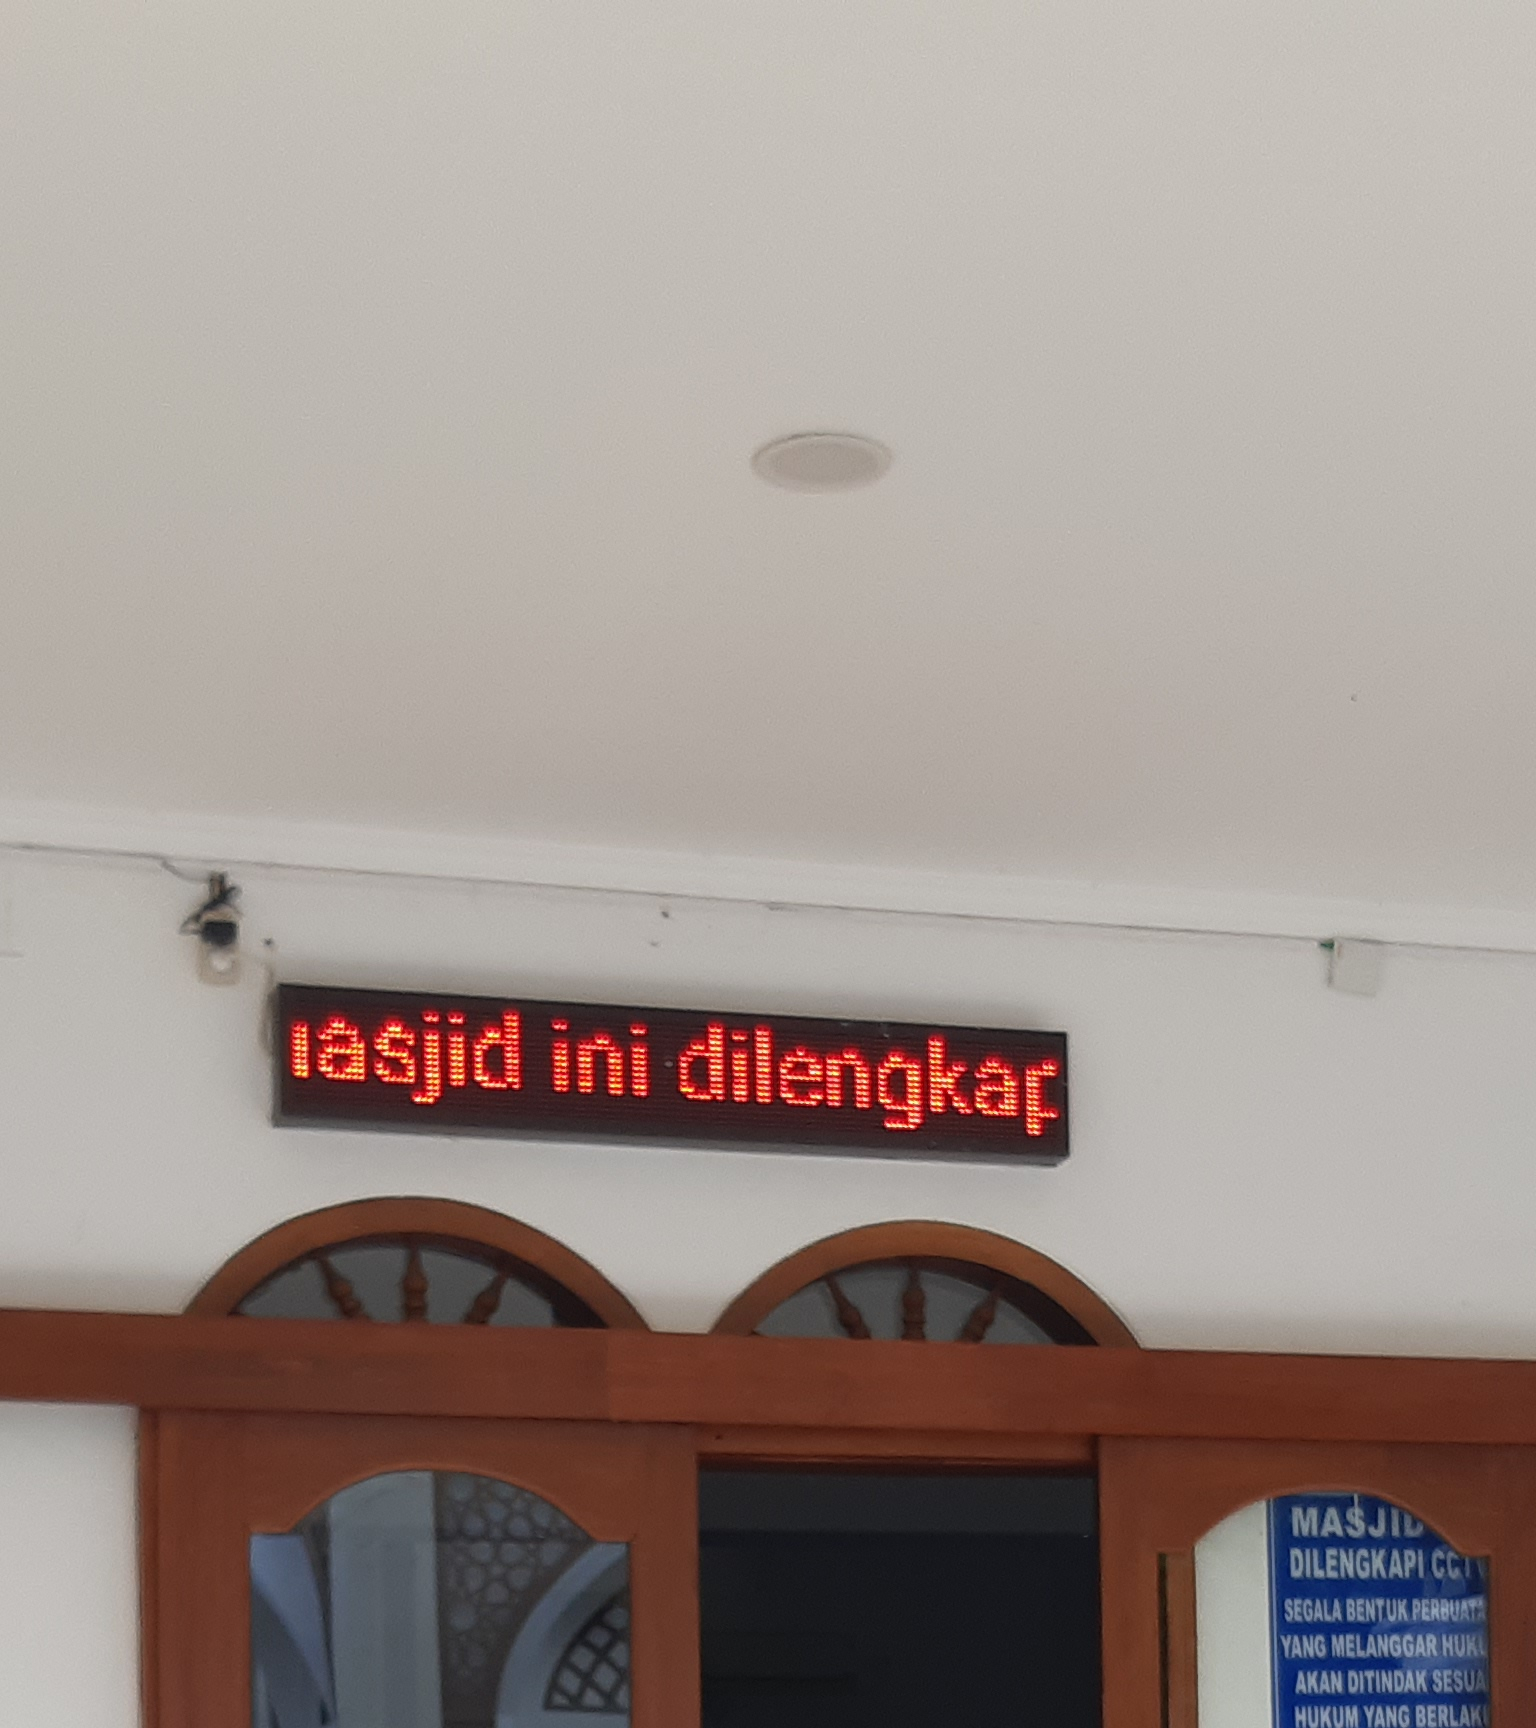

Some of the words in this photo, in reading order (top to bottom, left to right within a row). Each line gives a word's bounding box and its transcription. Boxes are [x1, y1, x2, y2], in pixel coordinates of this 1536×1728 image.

[288, 1010, 523, 1106] asjid
[550, 1018, 652, 1098] ini
[1291, 1506, 1424, 1538] MASJID
[1289, 1548, 1425, 1580] DILENGKAPI
[1284, 1598, 1342, 1622] SEGALA
[1346, 1598, 1408, 1622] BENTUK
[1280, 1634, 1326, 1658] YANG
[1331, 1633, 1437, 1658] MELANGGAR
[1295, 1670, 1342, 1694] AKAN
[1347, 1669, 1428, 1694] DITINDAK
[1294, 1706, 1359, 1728] HUKUM
[1364, 1705, 1410, 1728] YANG
